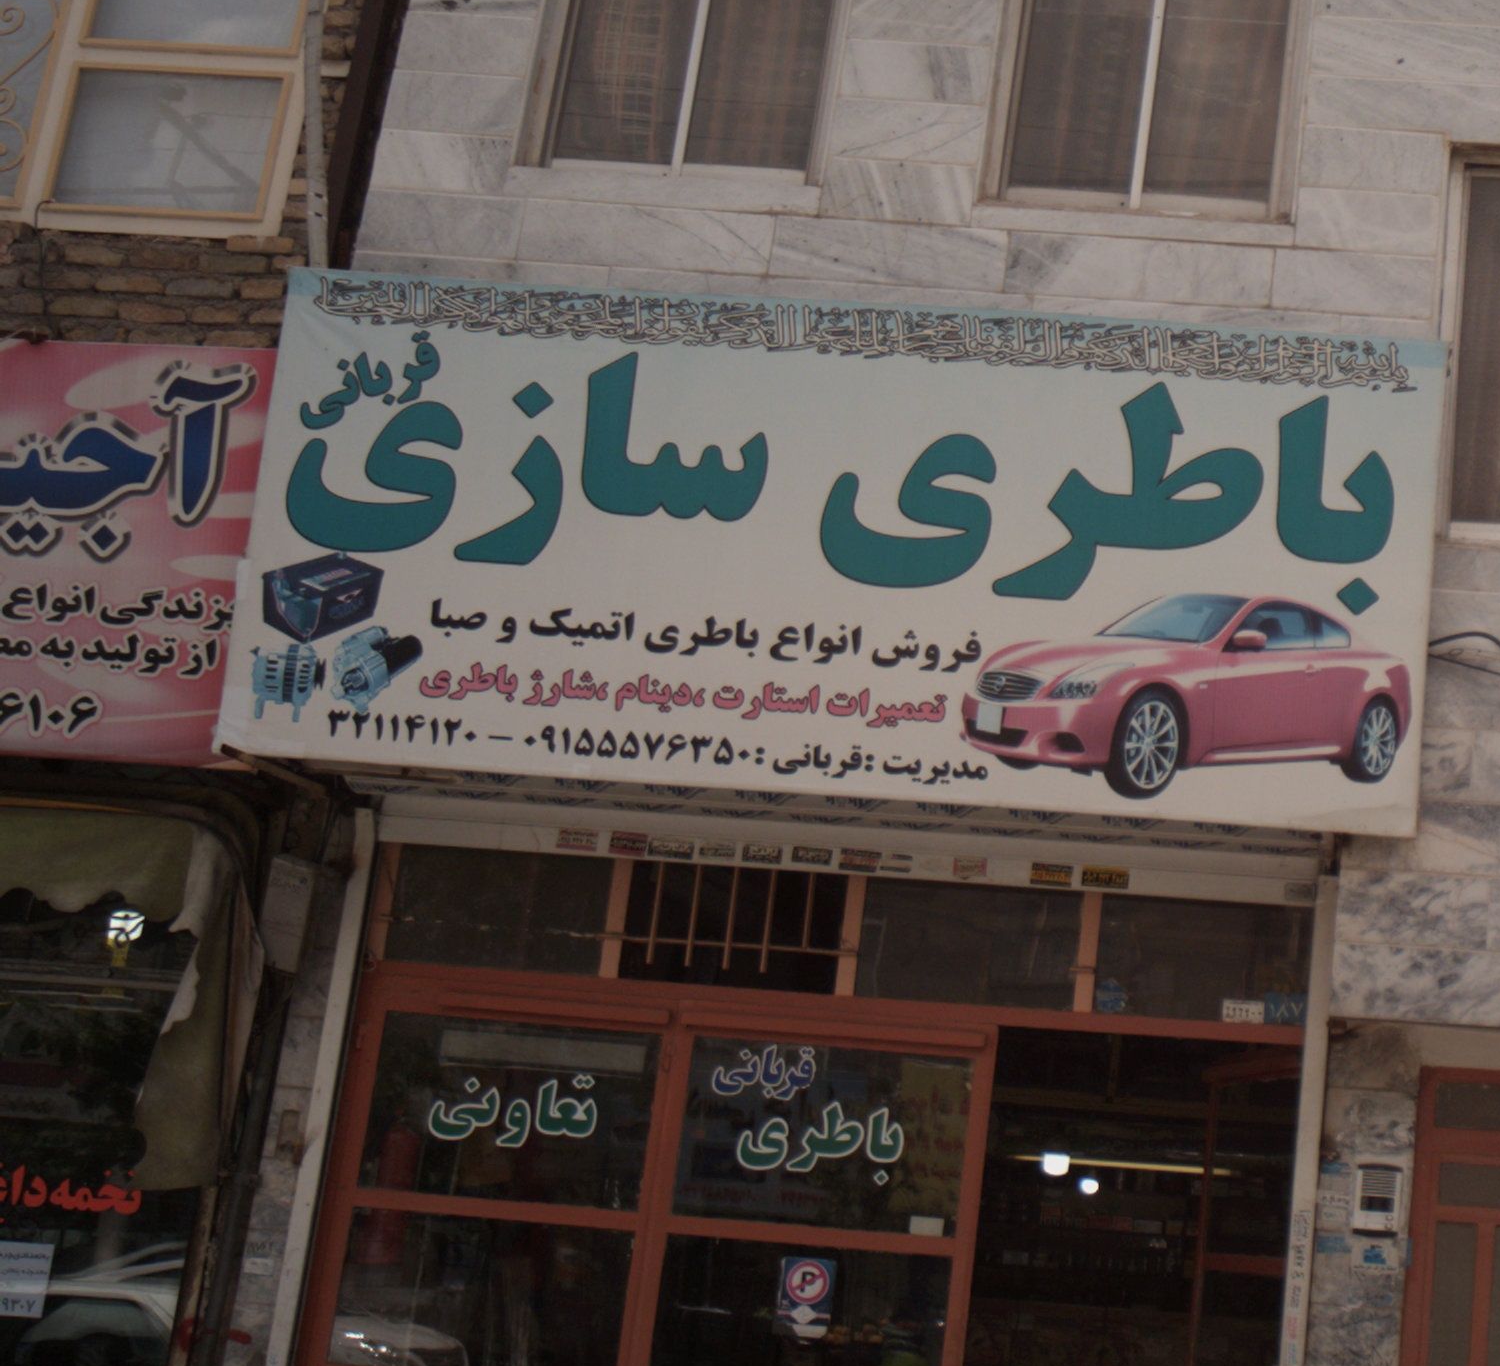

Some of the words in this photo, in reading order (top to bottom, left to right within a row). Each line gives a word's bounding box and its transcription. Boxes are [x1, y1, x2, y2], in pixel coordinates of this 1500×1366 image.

[300, 330, 441, 430] قربانی
[0, 373, 246, 553] آجی
[286, 352, 769, 566] سازی
[820, 381, 1395, 615] باطری
[2, 584, 96, 623] انواع
[430, 598, 488, 638] صبا
[495, 615, 517, 643] و
[529, 608, 635, 647] اتمیک
[644, 615, 760, 656] باطری
[769, 622, 862, 664] انواع
[40, 636, 75, 667] به
[82, 634, 176, 673] تولید
[181, 638, 217, 675] از
[872, 629, 982, 672] فروش
[419, 662, 518, 702] باطری
[713, 681, 820, 720] استارت
[826, 688, 948, 728] تعمیرات
[882, 754, 988, 784] مدیریت
[712, 1044, 816, 1101] قربانی
[429, 1074, 598, 1148] تعاونی
[736, 1100, 905, 1186] باطری
